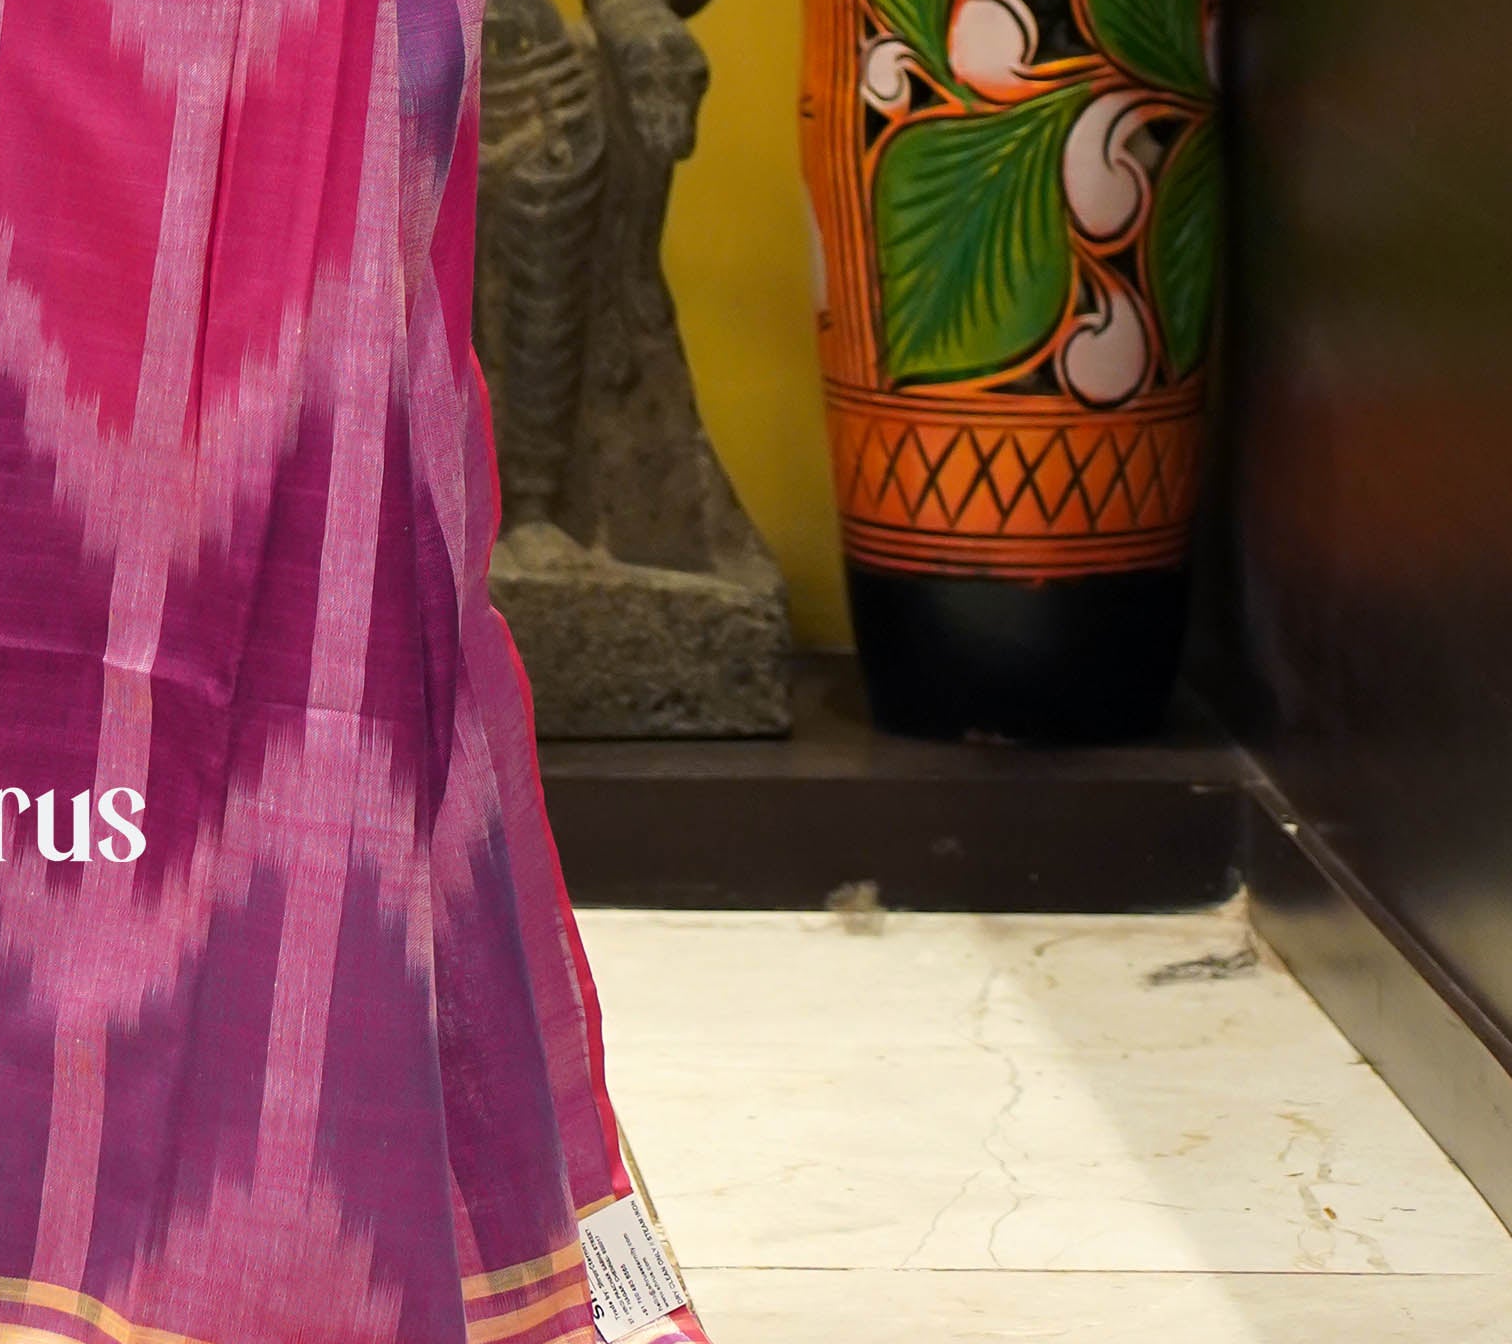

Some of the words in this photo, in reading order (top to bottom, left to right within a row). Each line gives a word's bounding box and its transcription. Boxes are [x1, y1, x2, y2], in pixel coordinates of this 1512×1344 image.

[629, 1200, 641, 1217] IRON
[637, 1218, 652, 1241] STEAM
[651, 1246, 664, 1265] ONLY
[660, 1266, 675, 1289] CLEAN
[672, 1289, 683, 1304] DRY
